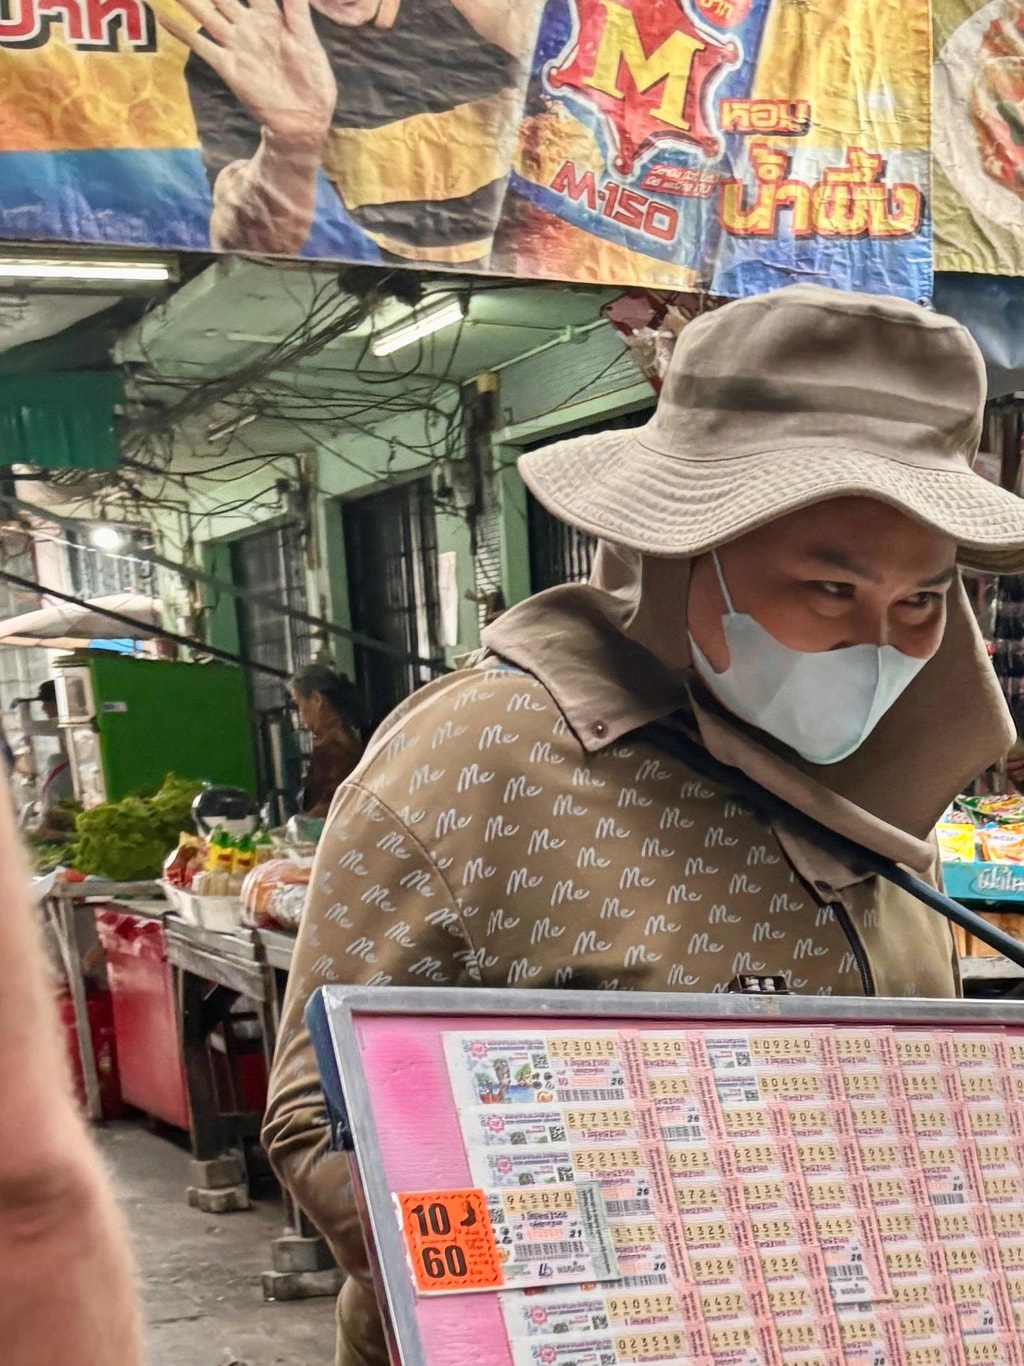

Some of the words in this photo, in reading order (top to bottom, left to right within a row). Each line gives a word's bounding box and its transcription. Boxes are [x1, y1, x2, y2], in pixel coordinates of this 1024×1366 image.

[550, 160, 679, 242] M-150
[507, 694, 547, 711] Me
[479, 724, 518, 750] Me
[529, 742, 565, 764] Me
[457, 764, 494, 792] Me
[573, 768, 605, 786] Me
[504, 777, 543, 802] Me
[618, 788, 652, 807] Me
[553, 795, 587, 815] Me
[436, 809, 472, 837] Me
[485, 816, 519, 841] Me
[596, 819, 630, 838] Me
[660, 808, 694, 828] Me
[377, 832, 411, 858] Me
[528, 829, 566, 855] Me
[642, 839, 675, 857] Me
[705, 828, 738, 847] Me
[340, 850, 368, 875] Me
[577, 848, 610, 867] Me
[685, 859, 719, 875] Me
[463, 858, 496, 885] Me
[507, 869, 543, 894] Me
[620, 868, 656, 889] Me
[401, 870, 435, 896] Me
[551, 880, 589, 906] Me
[729, 874, 761, 894] Me
[361, 885, 396, 911] Me
[667, 886, 702, 904] Me
[769, 895, 803, 913] Me
[600, 899, 635, 918] Me
[709, 905, 741, 923] Me
[487, 909, 520, 935] Me
[531, 918, 565, 944] Me
[645, 915, 681, 935] Me
[753, 923, 785, 942] Me
[385, 922, 416, 947] Me
[573, 931, 611, 956] Me
[688, 933, 723, 954] Me
[346, 938, 377, 962] Me
[624, 946, 662, 966] Me
[793, 939, 829, 959] Me
[409, 956, 447, 981] Me
[507, 959, 543, 983] Me
[732, 952, 766, 972] Me
[668, 963, 699, 984] Me
[411, 1203, 451, 1237] 10
[422, 1245, 467, 1279] 60
